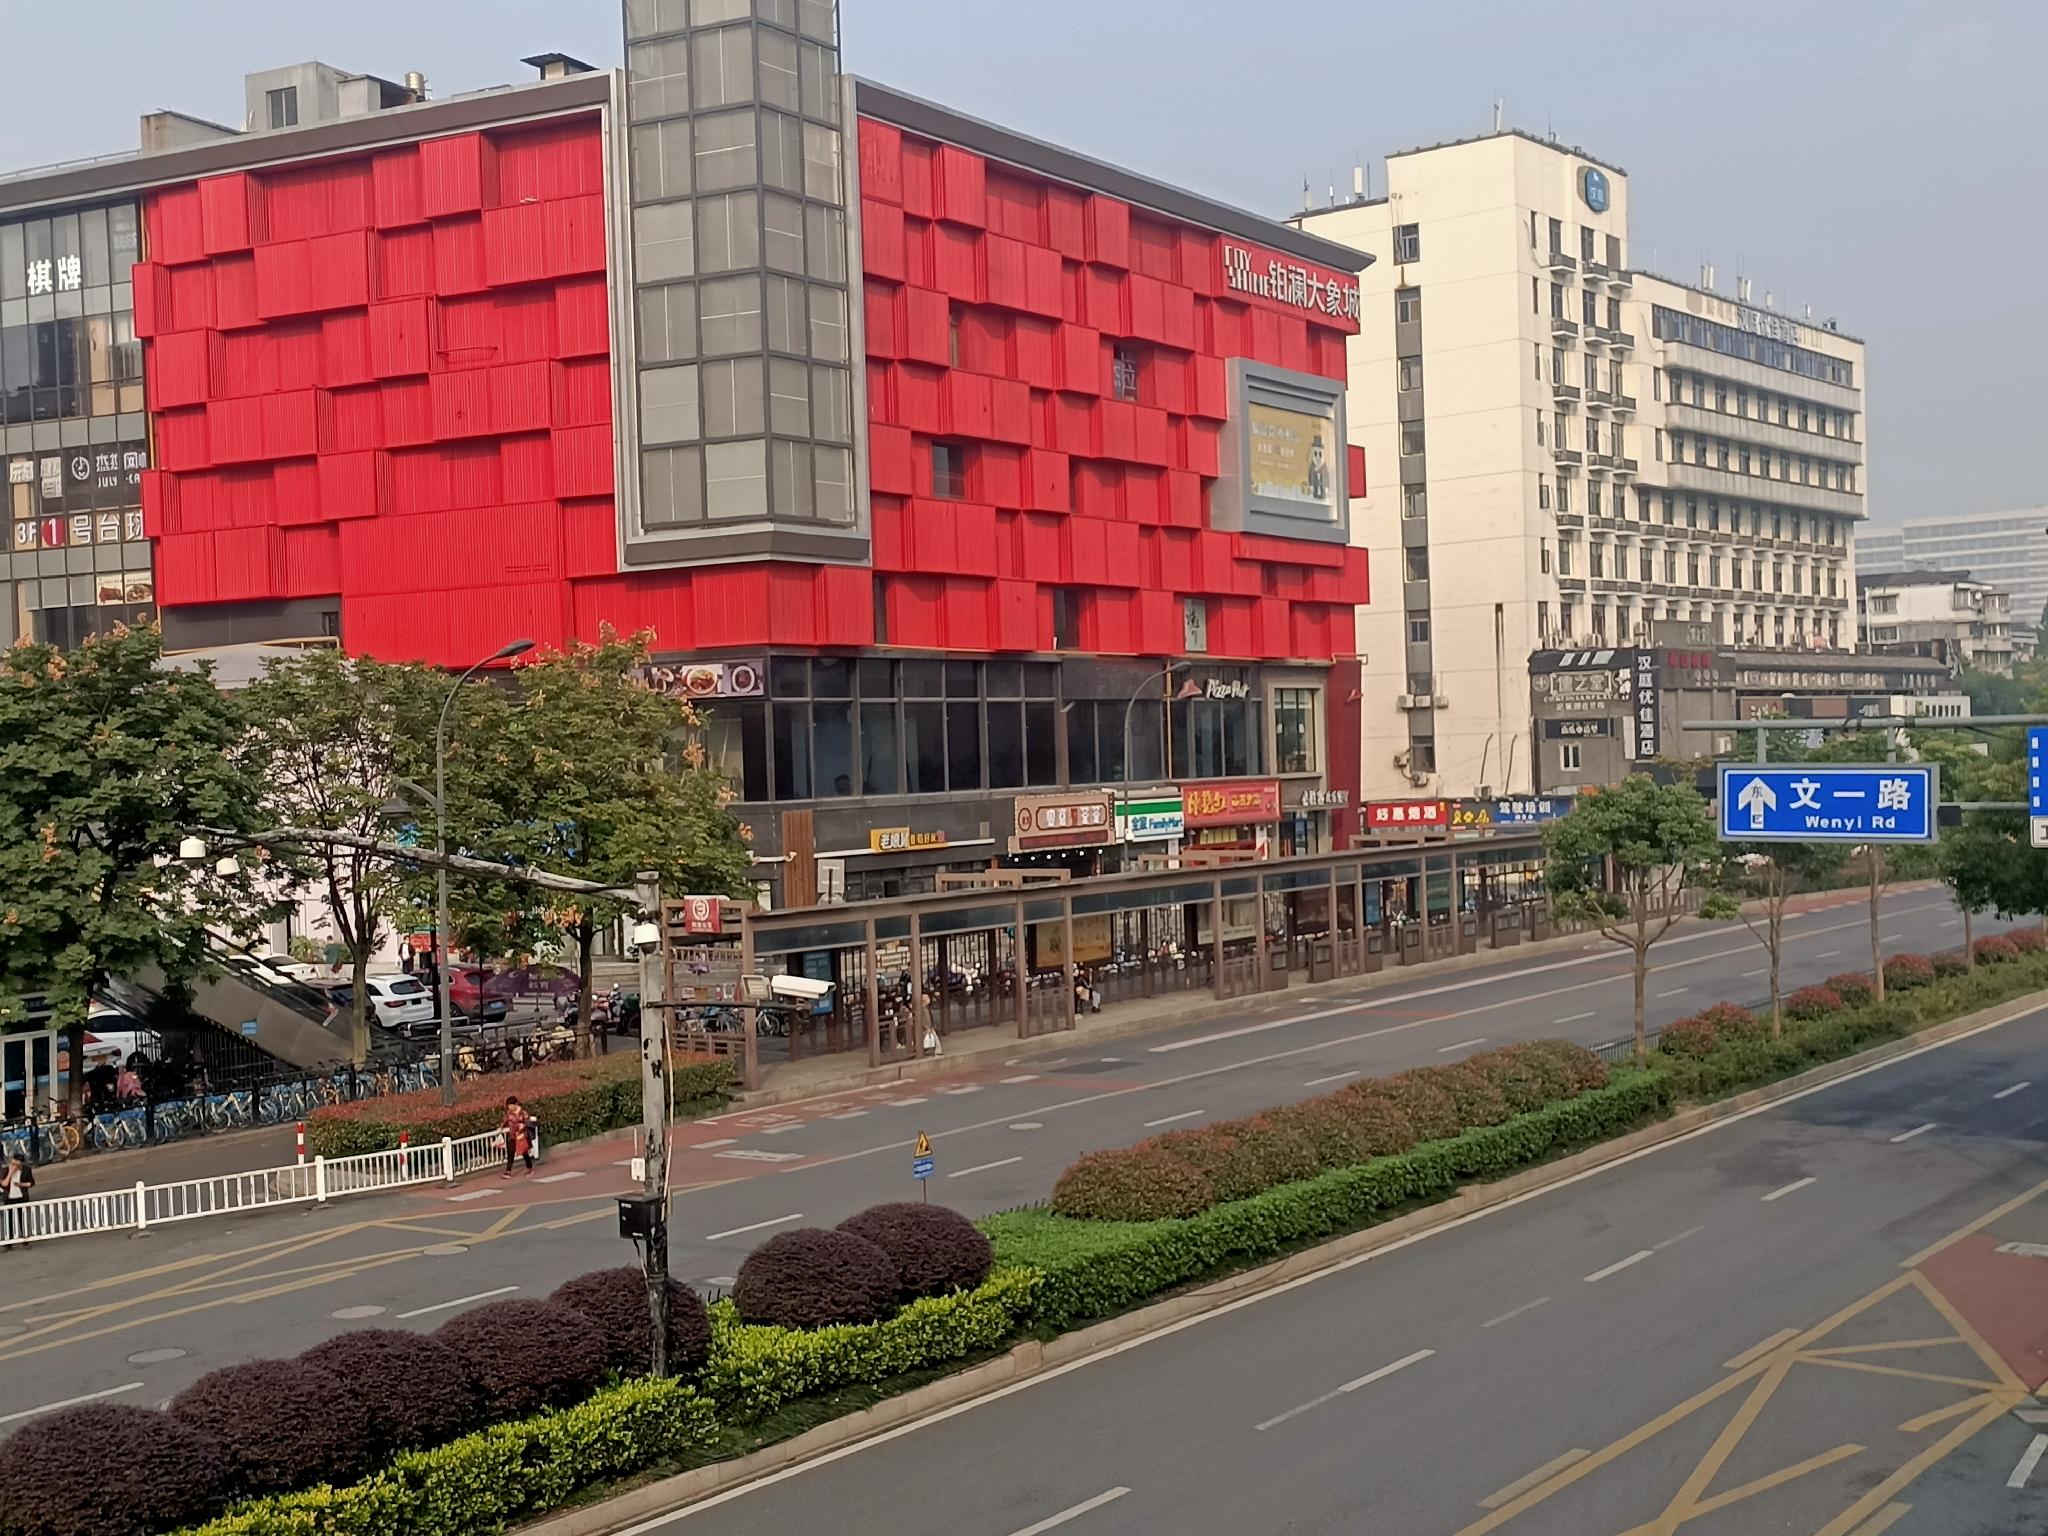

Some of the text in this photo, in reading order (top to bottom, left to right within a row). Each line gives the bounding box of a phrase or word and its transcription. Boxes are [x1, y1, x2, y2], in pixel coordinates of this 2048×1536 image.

[27, 254, 81, 295] 棋牌
[97, 474, 118, 489] JULY
[17, 521, 37, 544] 3F
[1206, 678, 1250, 699] Pizza Hut
[1789, 777, 1911, 811] 文一路
[1752, 814, 1763, 825] E
[1872, 816, 1896, 829] Rd
